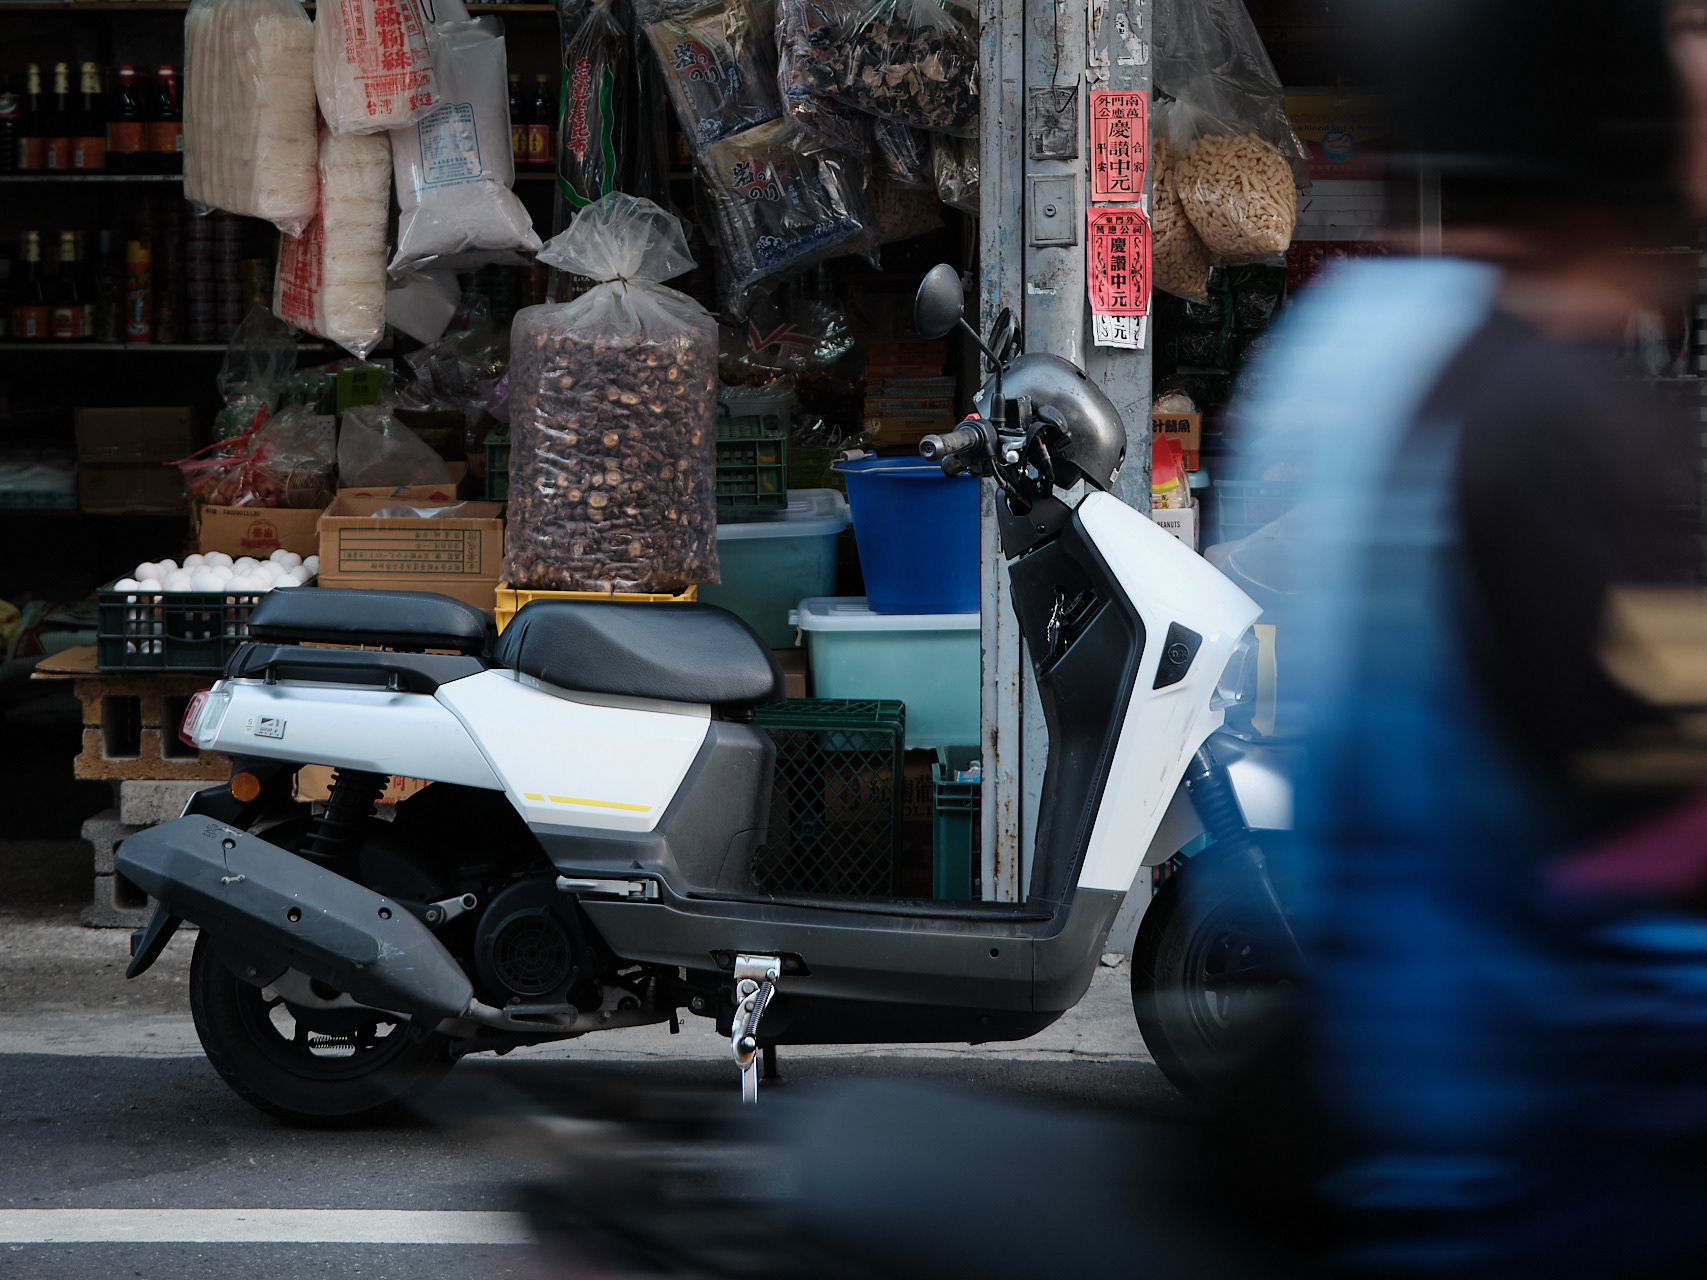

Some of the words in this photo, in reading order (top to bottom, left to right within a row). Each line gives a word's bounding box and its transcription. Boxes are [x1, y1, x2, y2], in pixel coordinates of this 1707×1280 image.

[1098, 96, 1139, 107] 南門外
[1099, 107, 1140, 118] 萬應公
